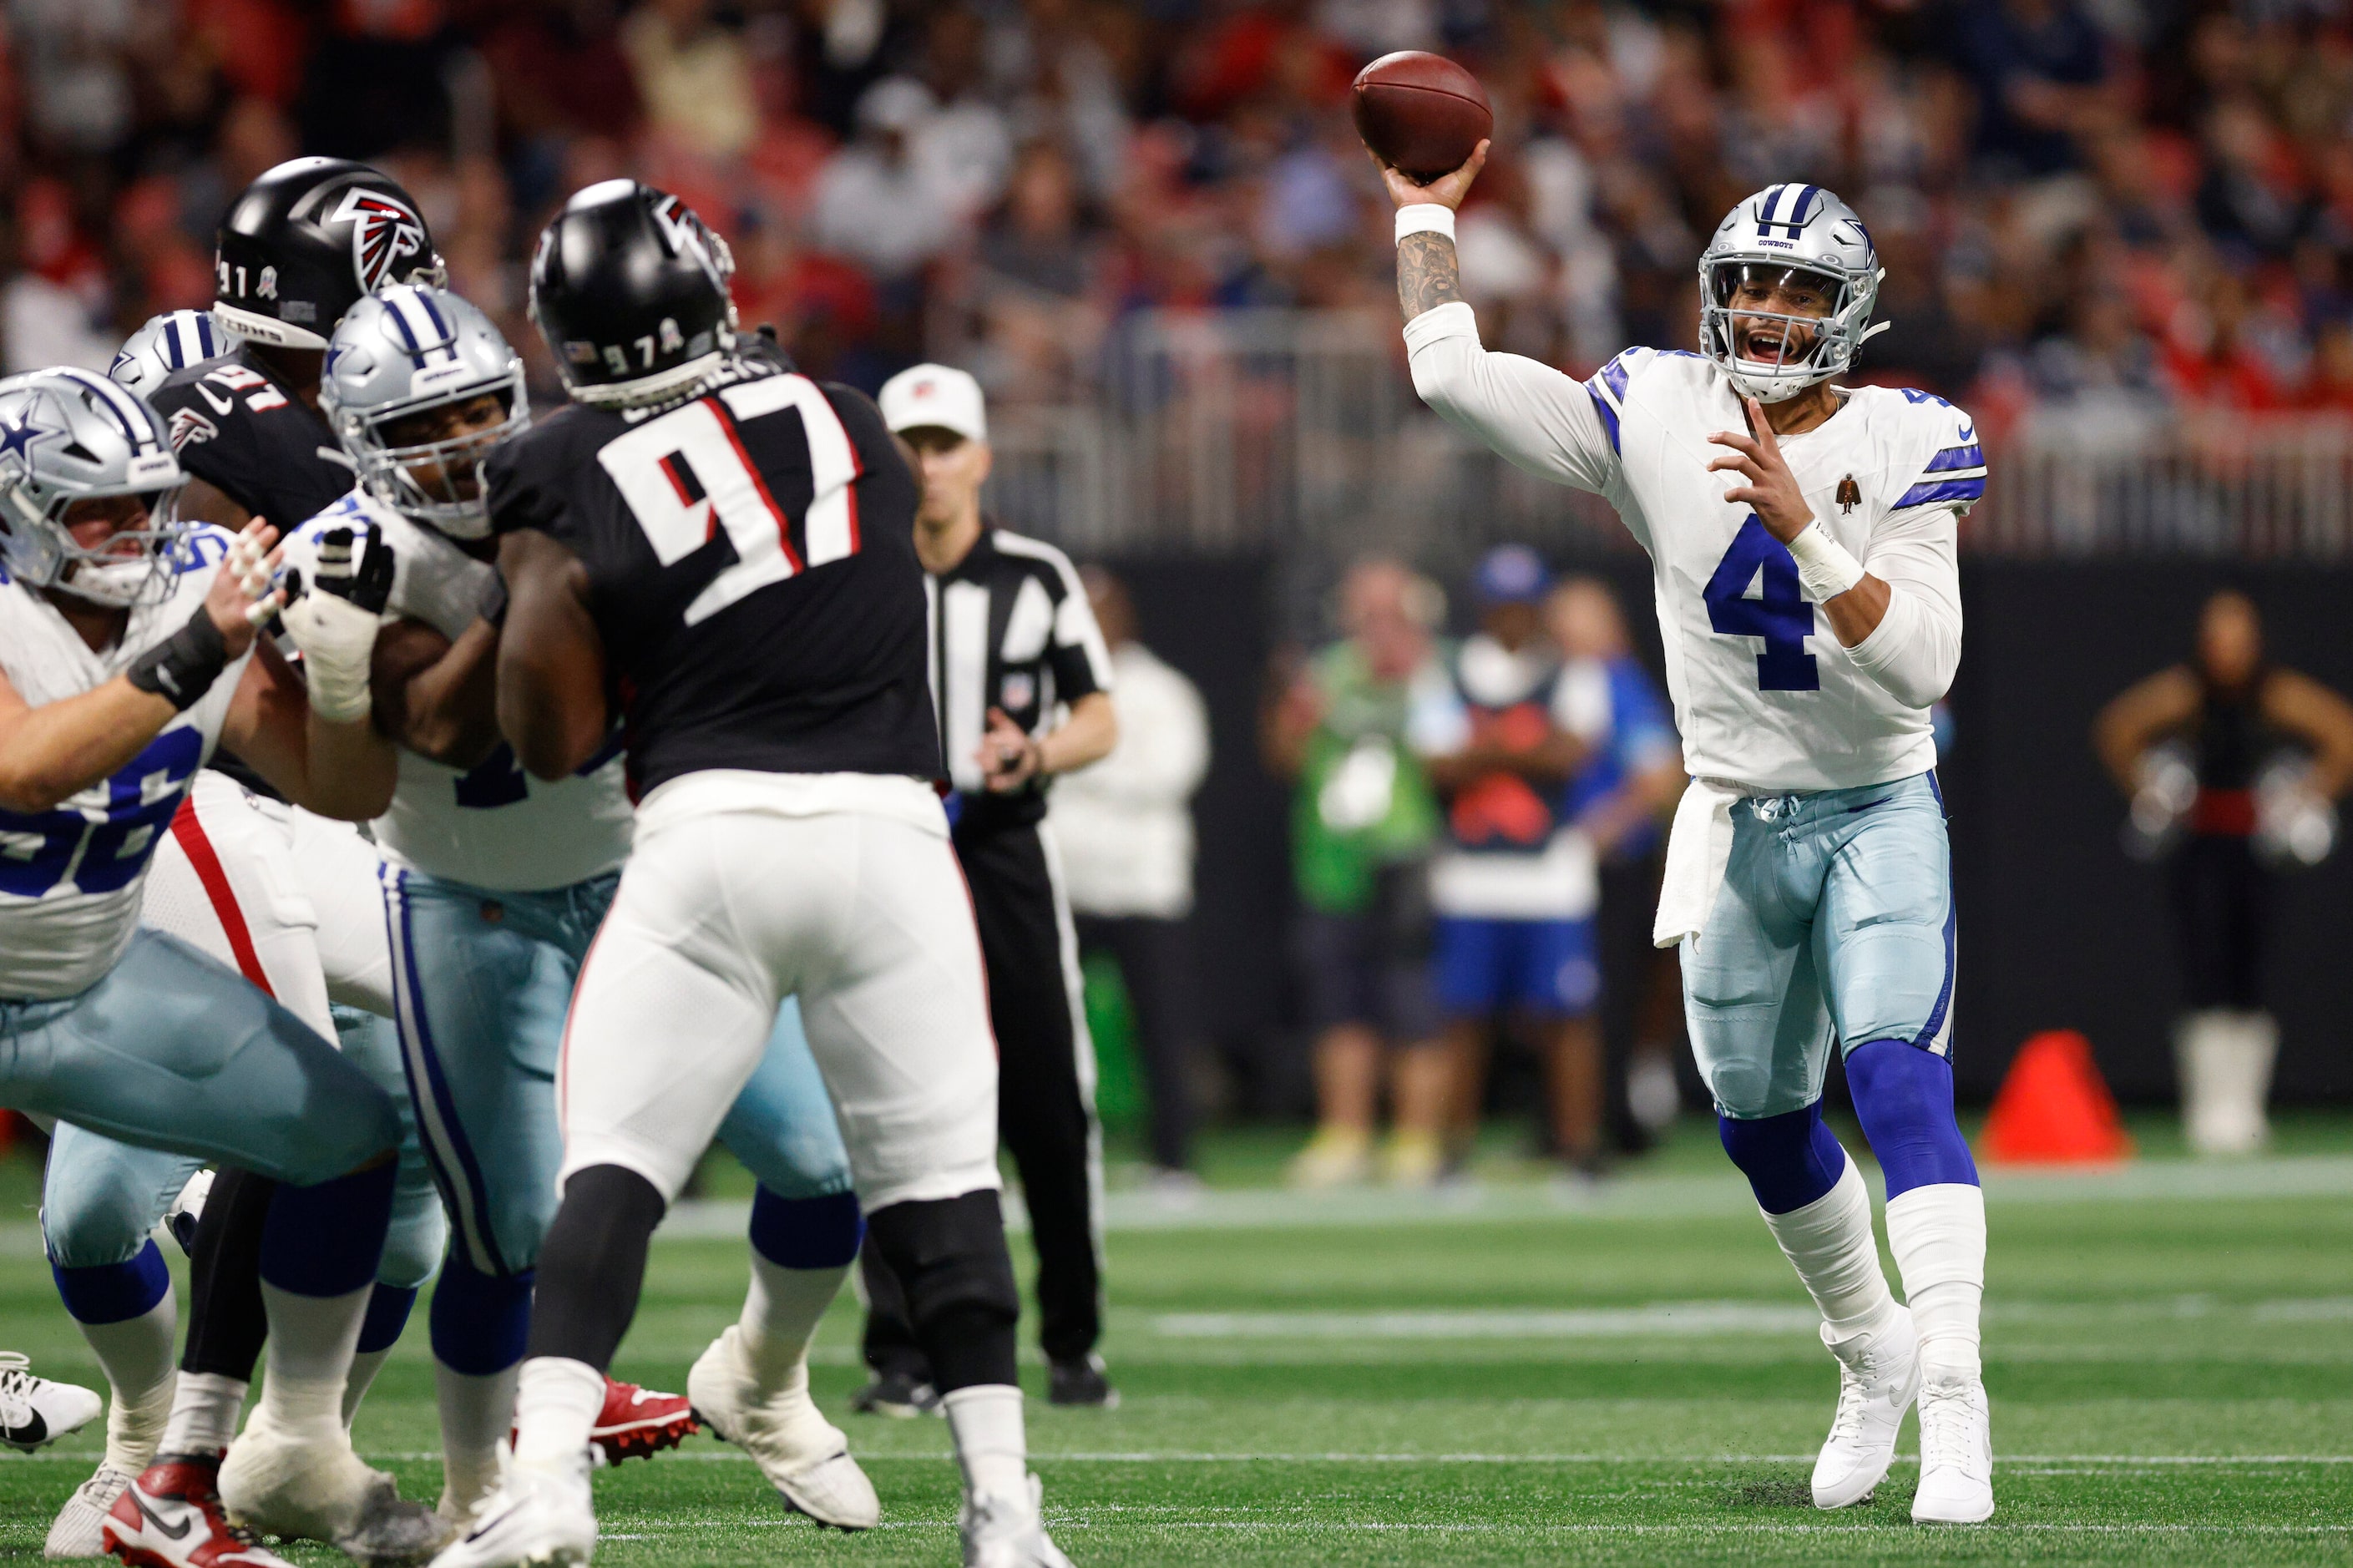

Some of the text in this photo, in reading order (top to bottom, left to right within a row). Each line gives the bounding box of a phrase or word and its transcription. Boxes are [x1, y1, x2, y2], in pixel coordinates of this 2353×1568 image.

[1758, 240, 1794, 250] COWBOYS
[602, 334, 655, 375] 97
[596, 372, 864, 628] 97
[1702, 513, 1820, 691] 4
